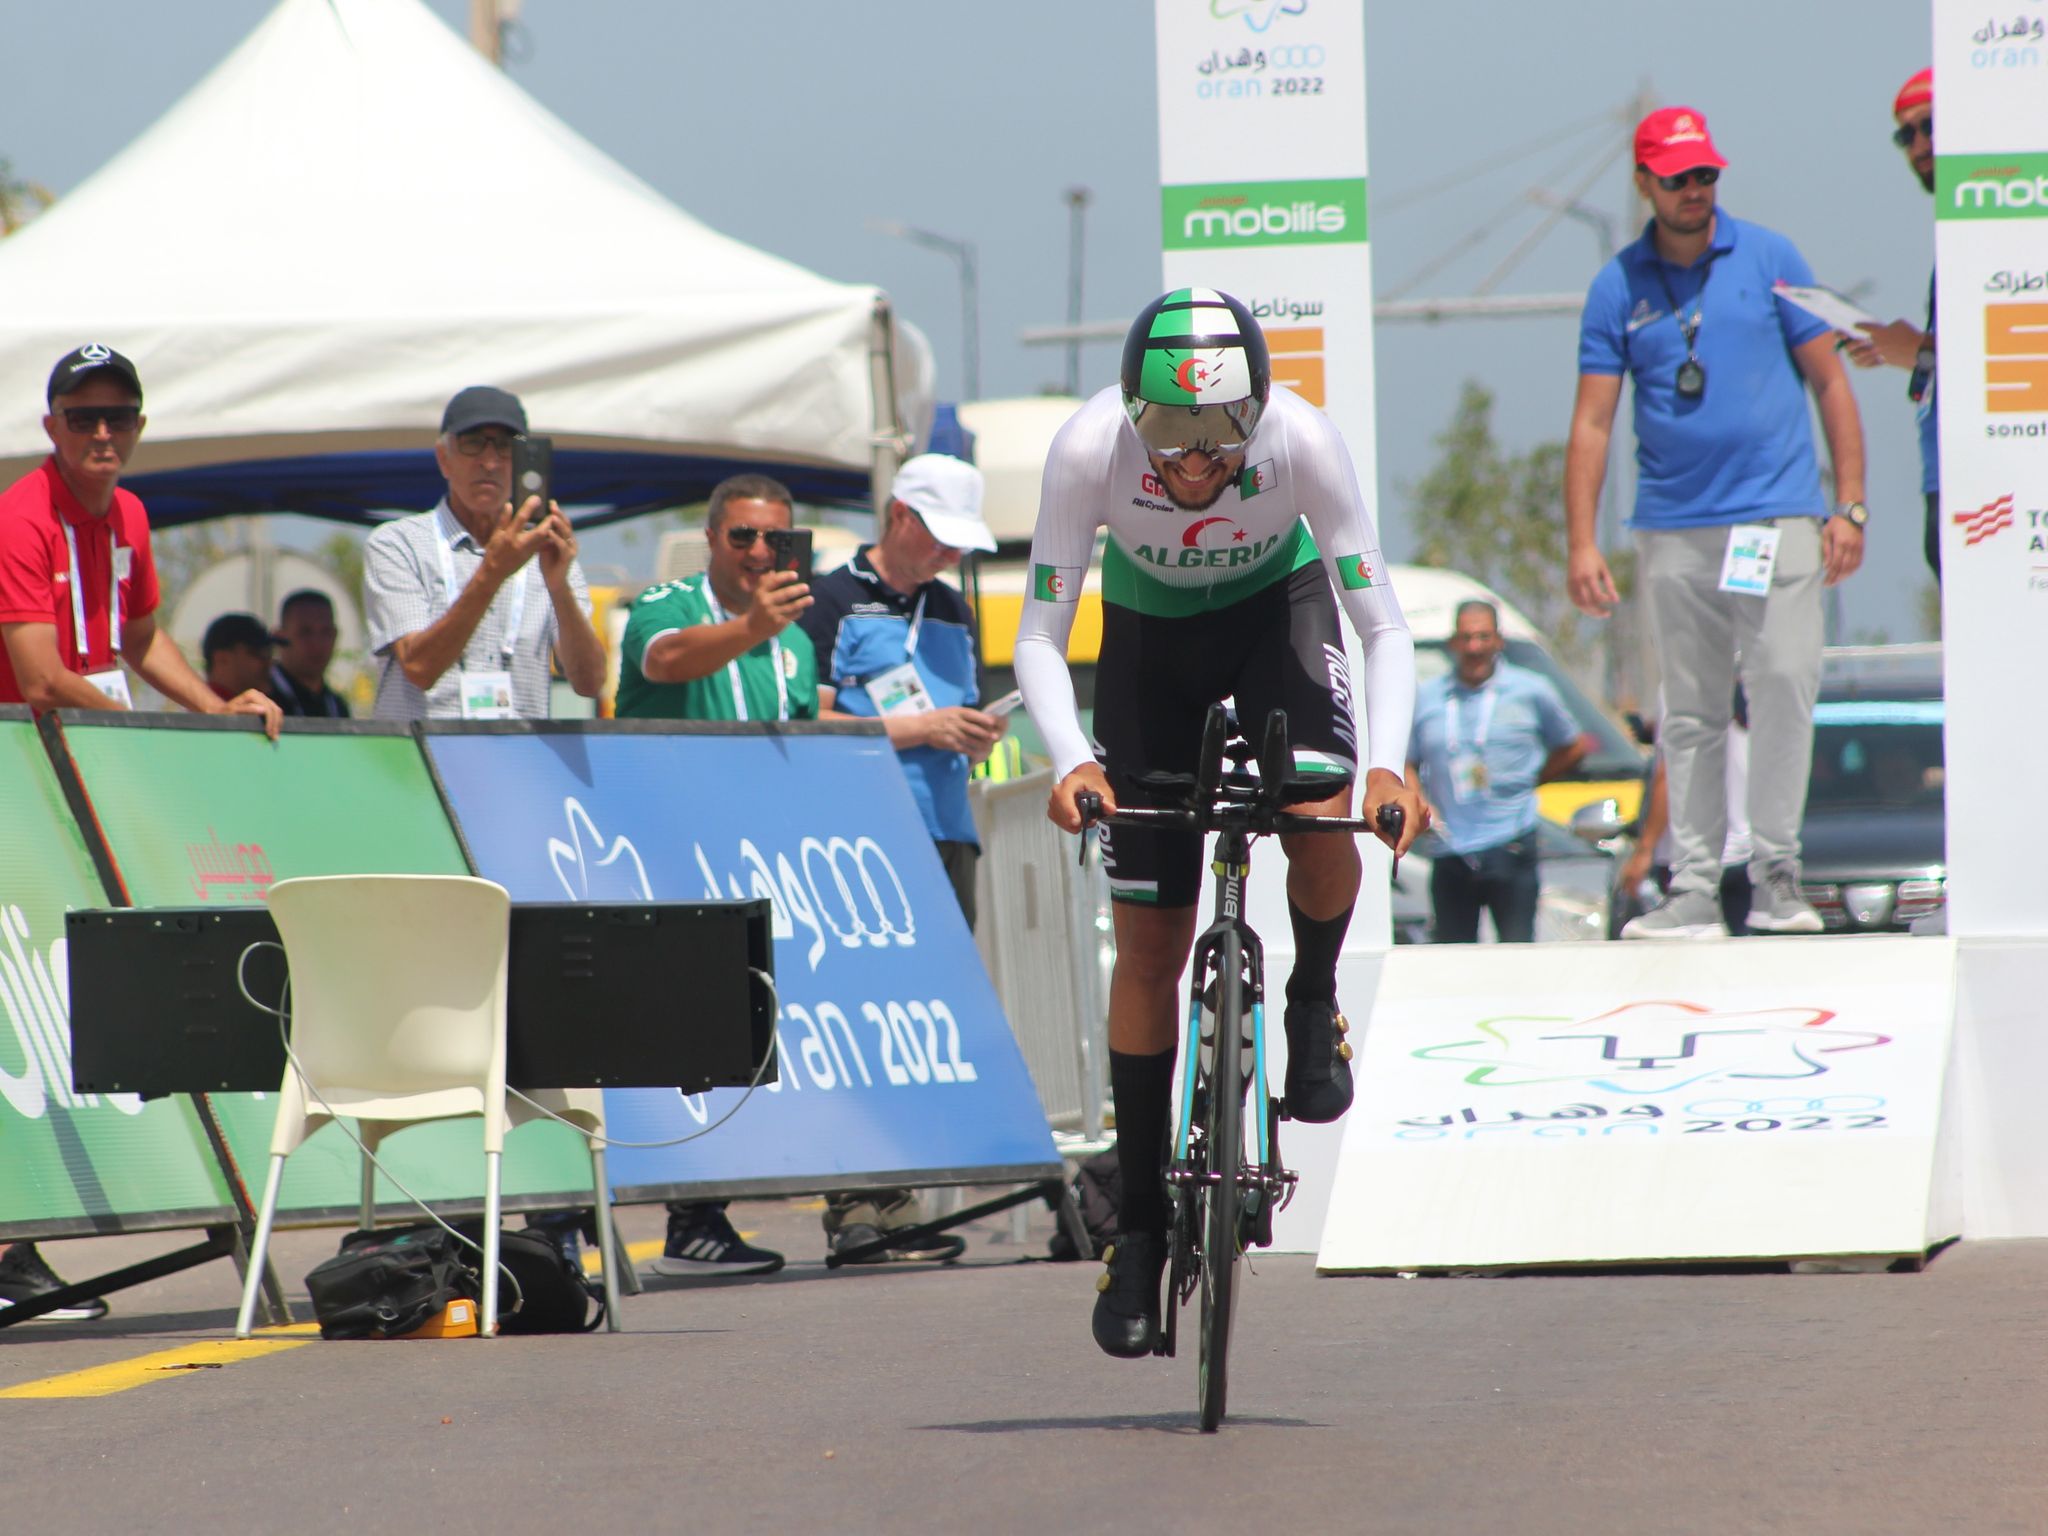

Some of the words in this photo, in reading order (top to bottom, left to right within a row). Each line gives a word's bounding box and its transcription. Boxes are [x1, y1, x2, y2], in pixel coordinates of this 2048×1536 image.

[1971, 48, 2038, 69] oran
[1197, 78, 1261, 98] oran
[1271, 77, 1323, 95] 2022
[1184, 202, 1346, 238] mobilis
[1134, 534, 1279, 569] ALGERIA
[1224, 863, 1239, 919] BMC
[861, 1000, 978, 1086] 2022
[1683, 1114, 1889, 1135] 2022
